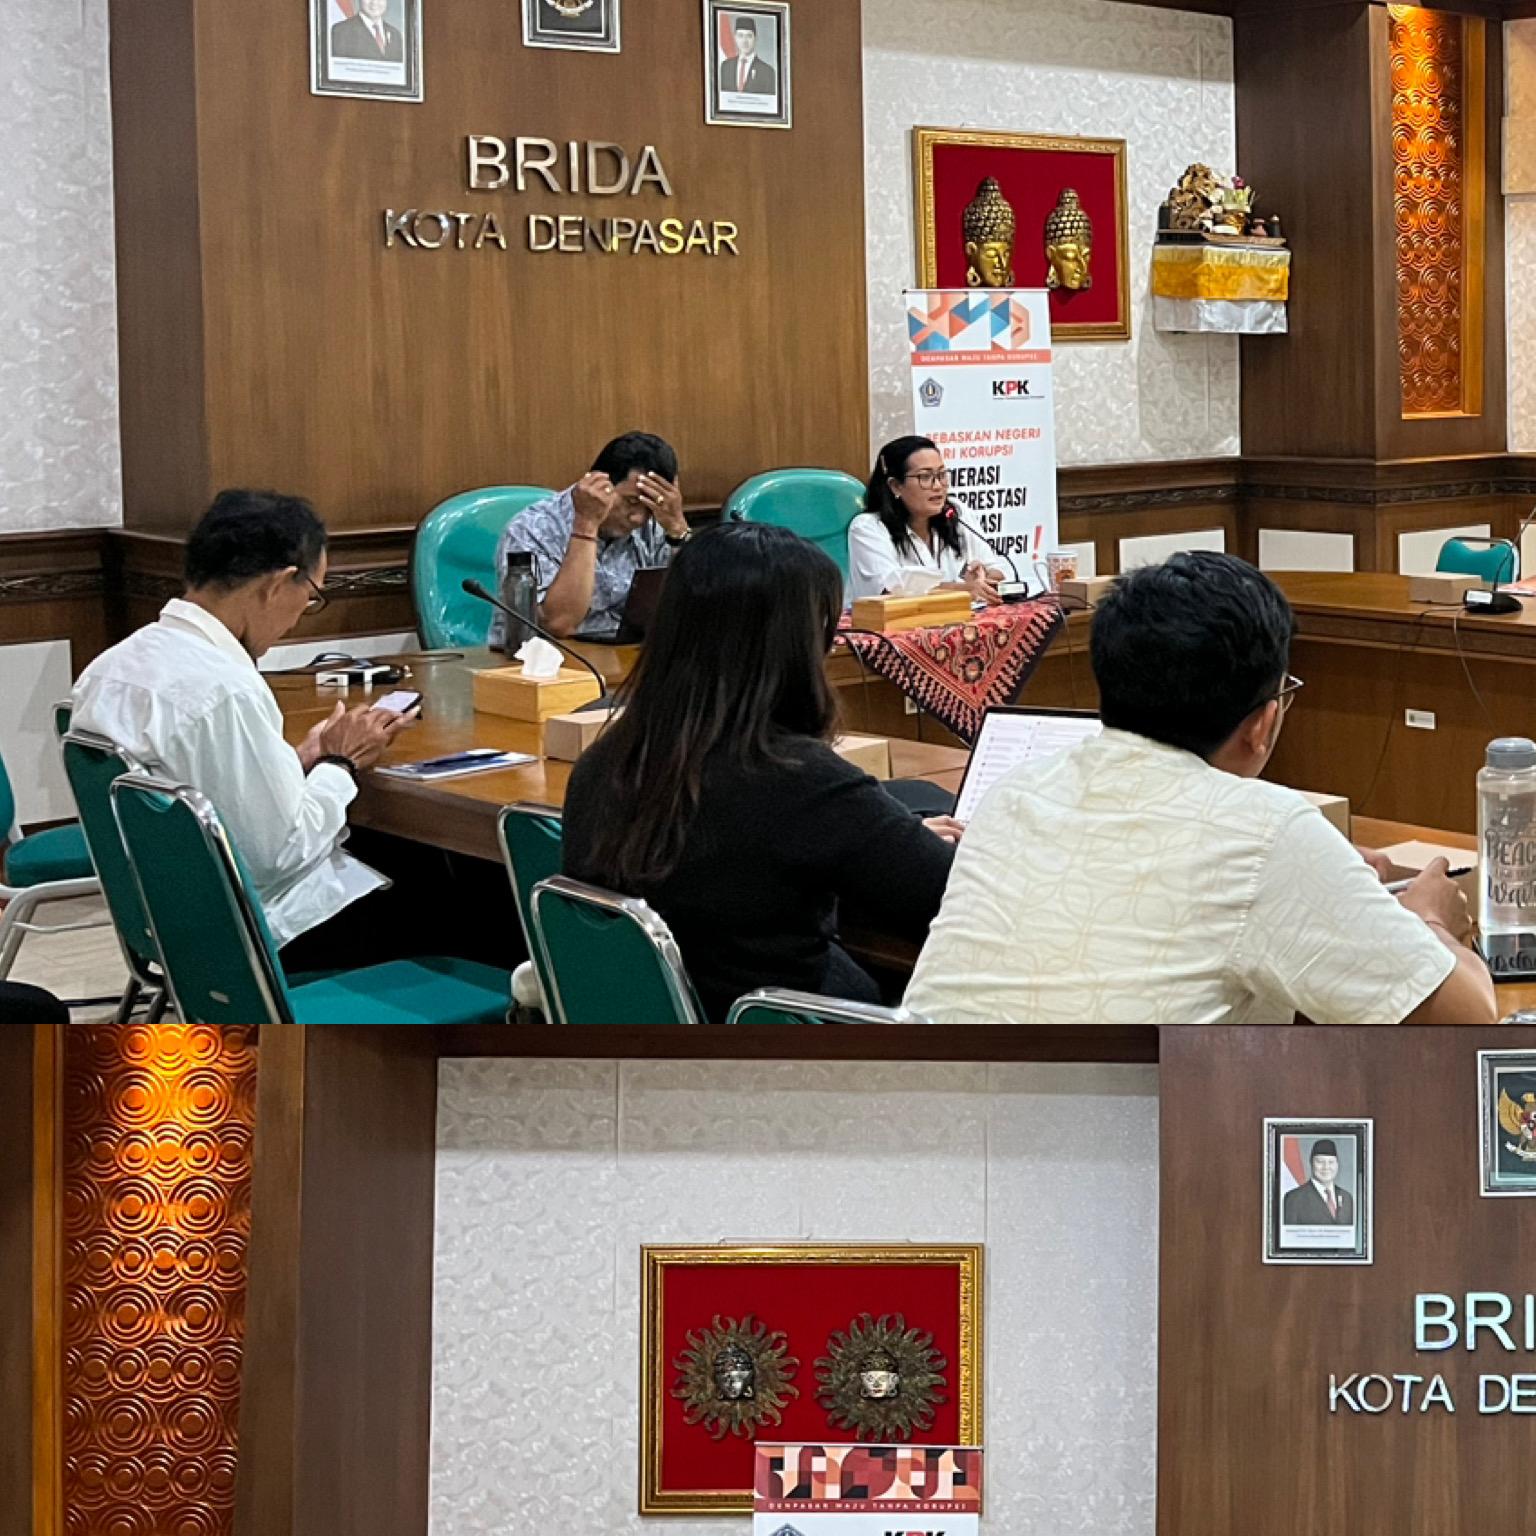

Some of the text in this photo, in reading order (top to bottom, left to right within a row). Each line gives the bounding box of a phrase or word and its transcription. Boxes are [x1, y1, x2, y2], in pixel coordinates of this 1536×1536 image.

[468, 135, 672, 196] BRIDA
[384, 208, 740, 256] KOTA DENPASAR
[993, 379, 1030, 395] KPK
[996, 427, 1041, 441] NEGERI
[943, 444, 1014, 461] RI KORUPSI
[1328, 1373, 1456, 1414] KOTA
